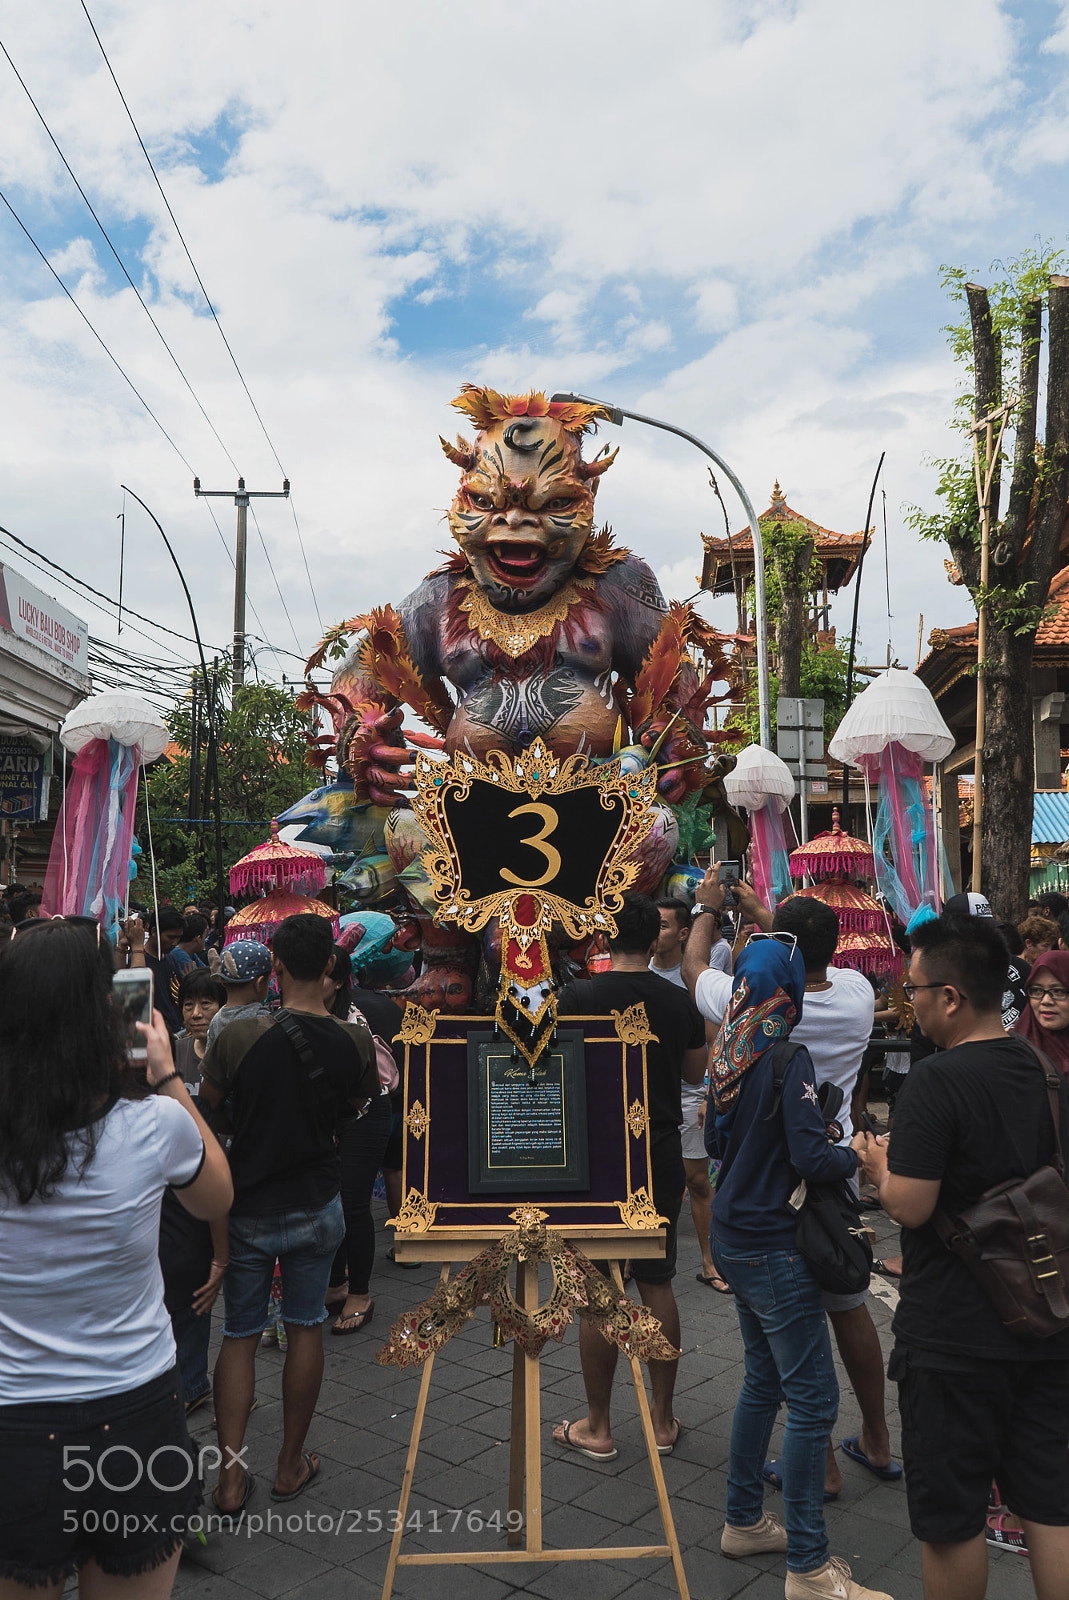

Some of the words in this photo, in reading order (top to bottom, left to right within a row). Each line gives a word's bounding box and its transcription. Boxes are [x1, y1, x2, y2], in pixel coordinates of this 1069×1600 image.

[19, 596, 39, 628] LUCKY
[40, 611, 54, 638] BALI
[54, 621, 66, 646] BOB
[66, 630, 80, 655] SHOP
[499, 802, 562, 887] 3
